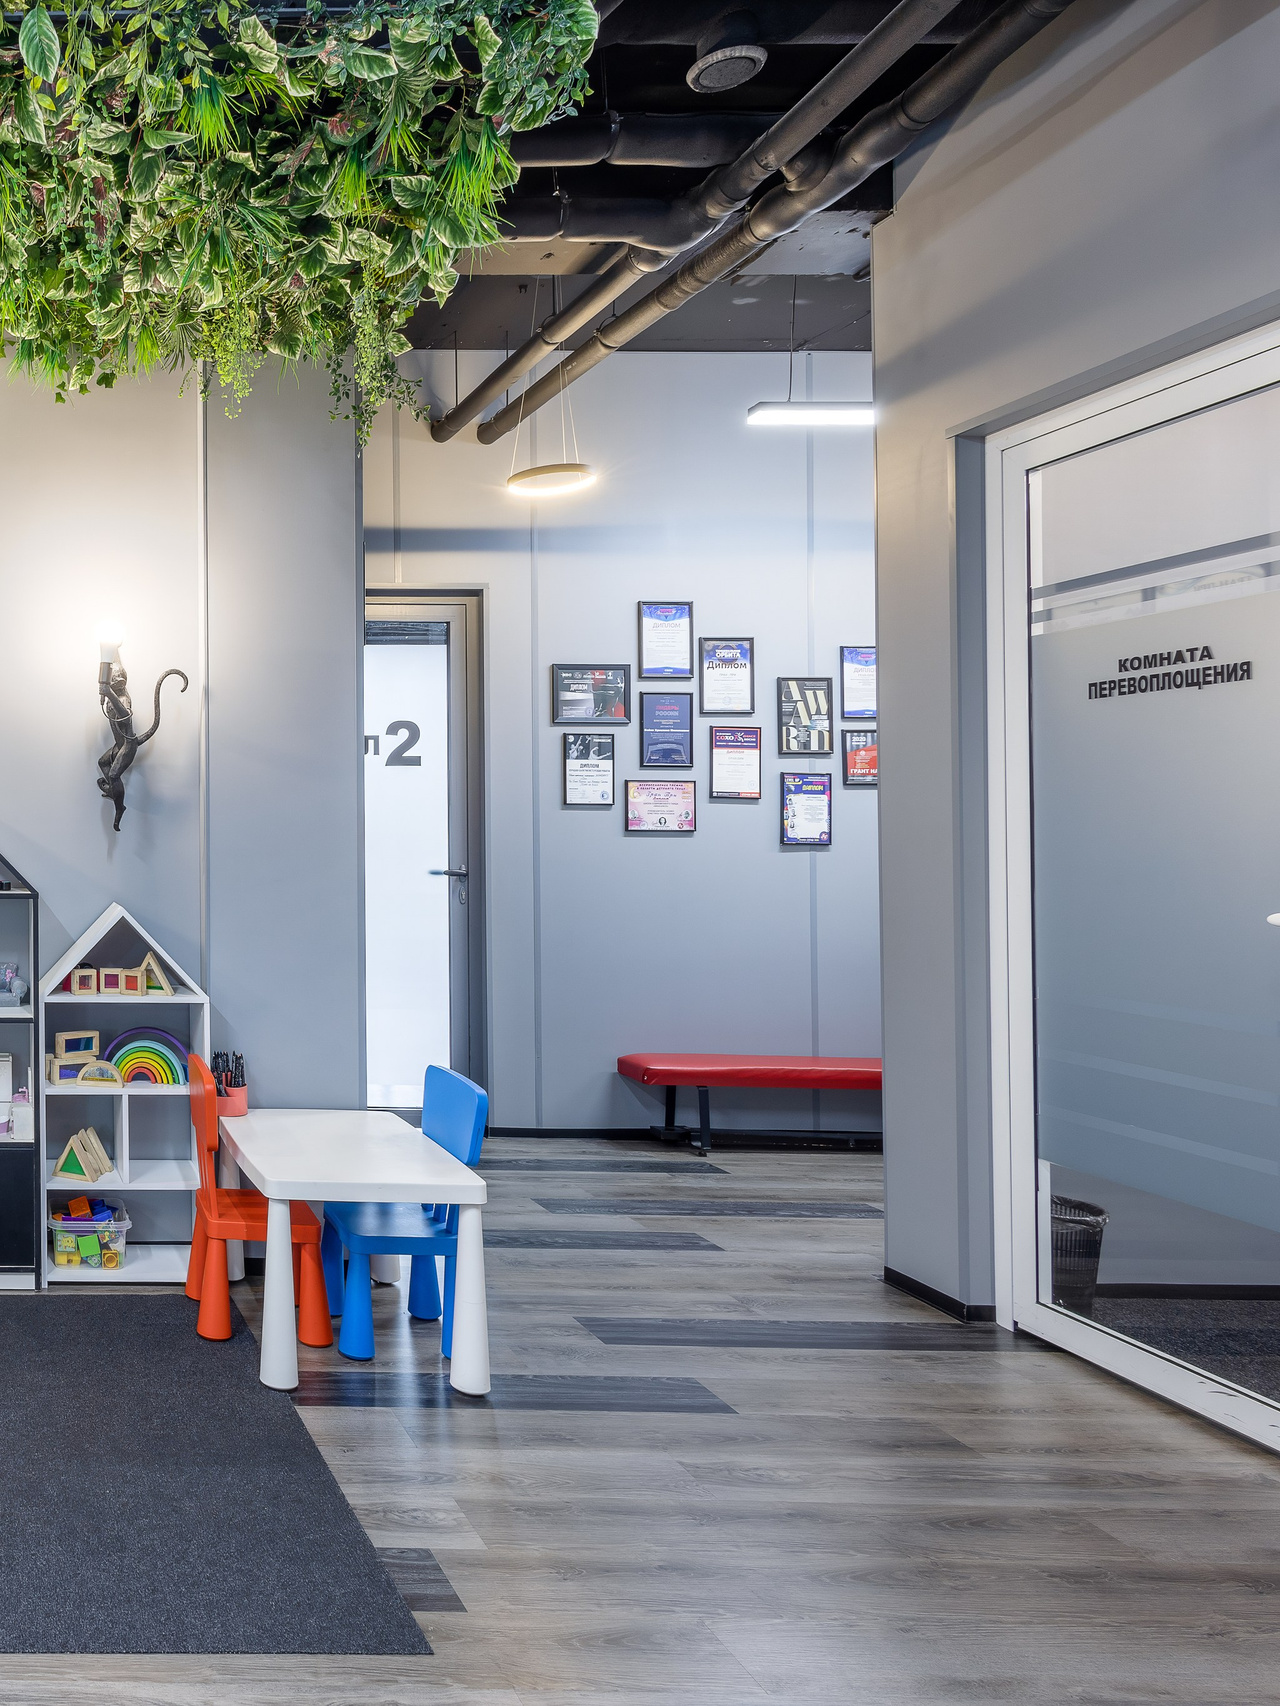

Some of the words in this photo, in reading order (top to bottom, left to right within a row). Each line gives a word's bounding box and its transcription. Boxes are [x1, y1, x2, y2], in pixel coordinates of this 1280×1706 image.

[706, 660, 747, 671] Диплом
[1118, 645, 1213, 673] КОМНАТА
[1088, 660, 1252, 700] ПЕРЕВОПЛОЩЕНИЯ
[385, 720, 422, 767] 2
